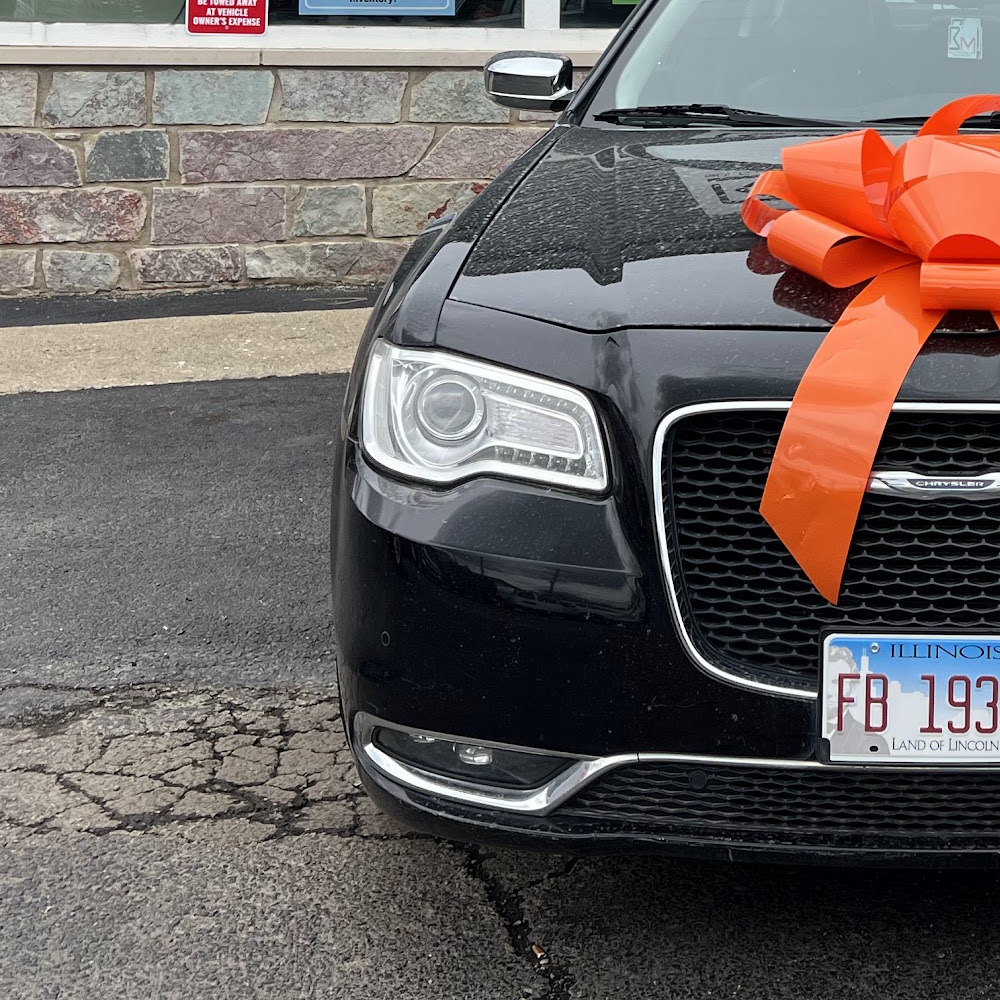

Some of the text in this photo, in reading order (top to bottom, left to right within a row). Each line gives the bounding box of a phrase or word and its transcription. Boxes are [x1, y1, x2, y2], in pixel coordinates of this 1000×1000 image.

[206, 8, 248, 17] AT VEHICLE
[193, 17, 261, 27] OWNER'S EXPENSE
[915, 480, 985, 488] CHRYSLER
[837, 673, 888, 733] FB
[892, 737, 927, 752] LAND
[948, 737, 999, 752] LINCOLN
